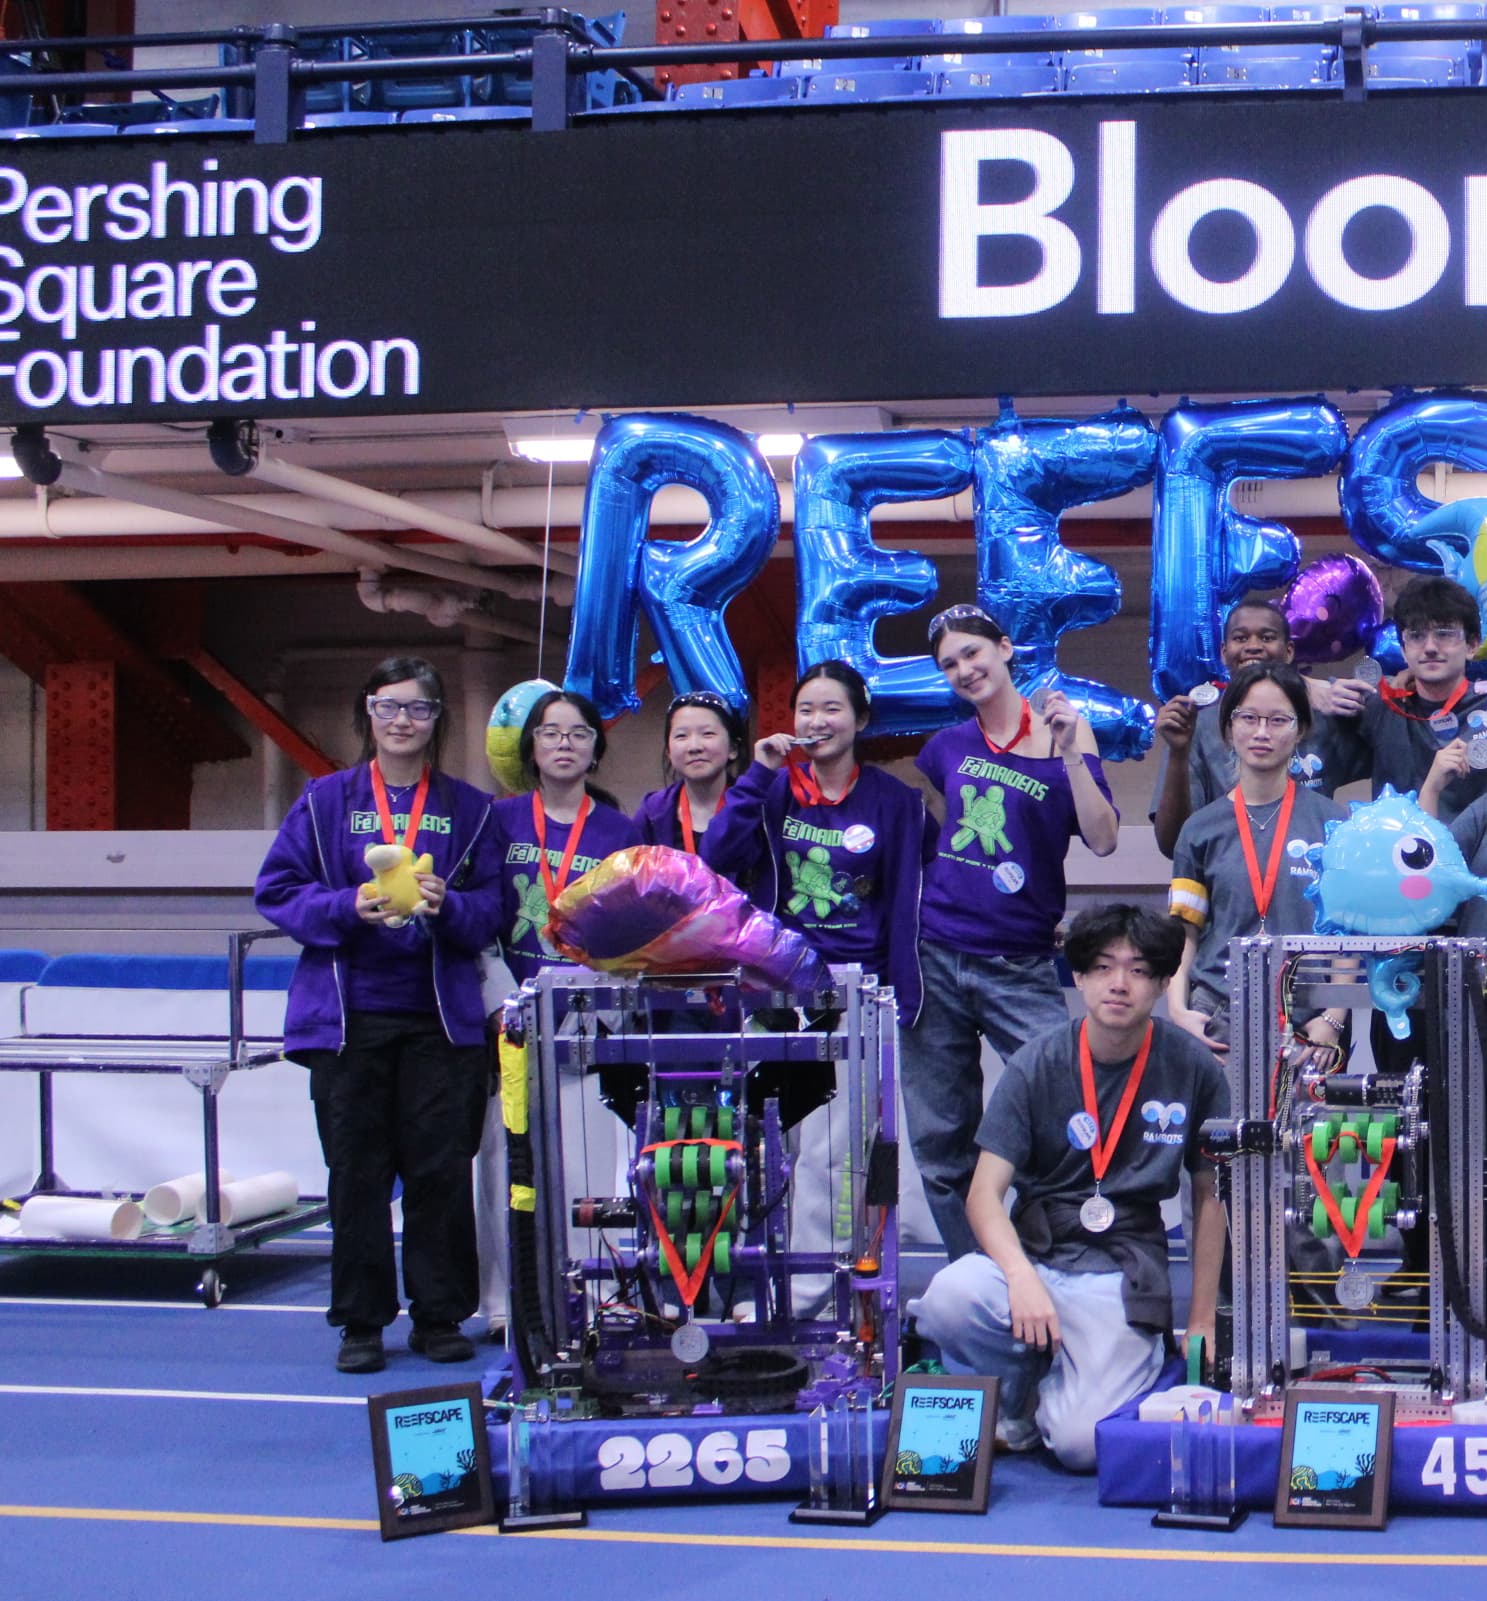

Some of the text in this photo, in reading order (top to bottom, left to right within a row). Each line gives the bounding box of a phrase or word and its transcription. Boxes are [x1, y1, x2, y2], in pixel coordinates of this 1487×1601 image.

[1143, 1131, 1184, 1145] RAMBOTS
[911, 1396, 975, 1411] REEFSCAPE
[394, 1407, 463, 1429] REEFSCAPE
[1304, 1410, 1371, 1425] REEFSCAPE
[597, 1428, 791, 1490] 2265
